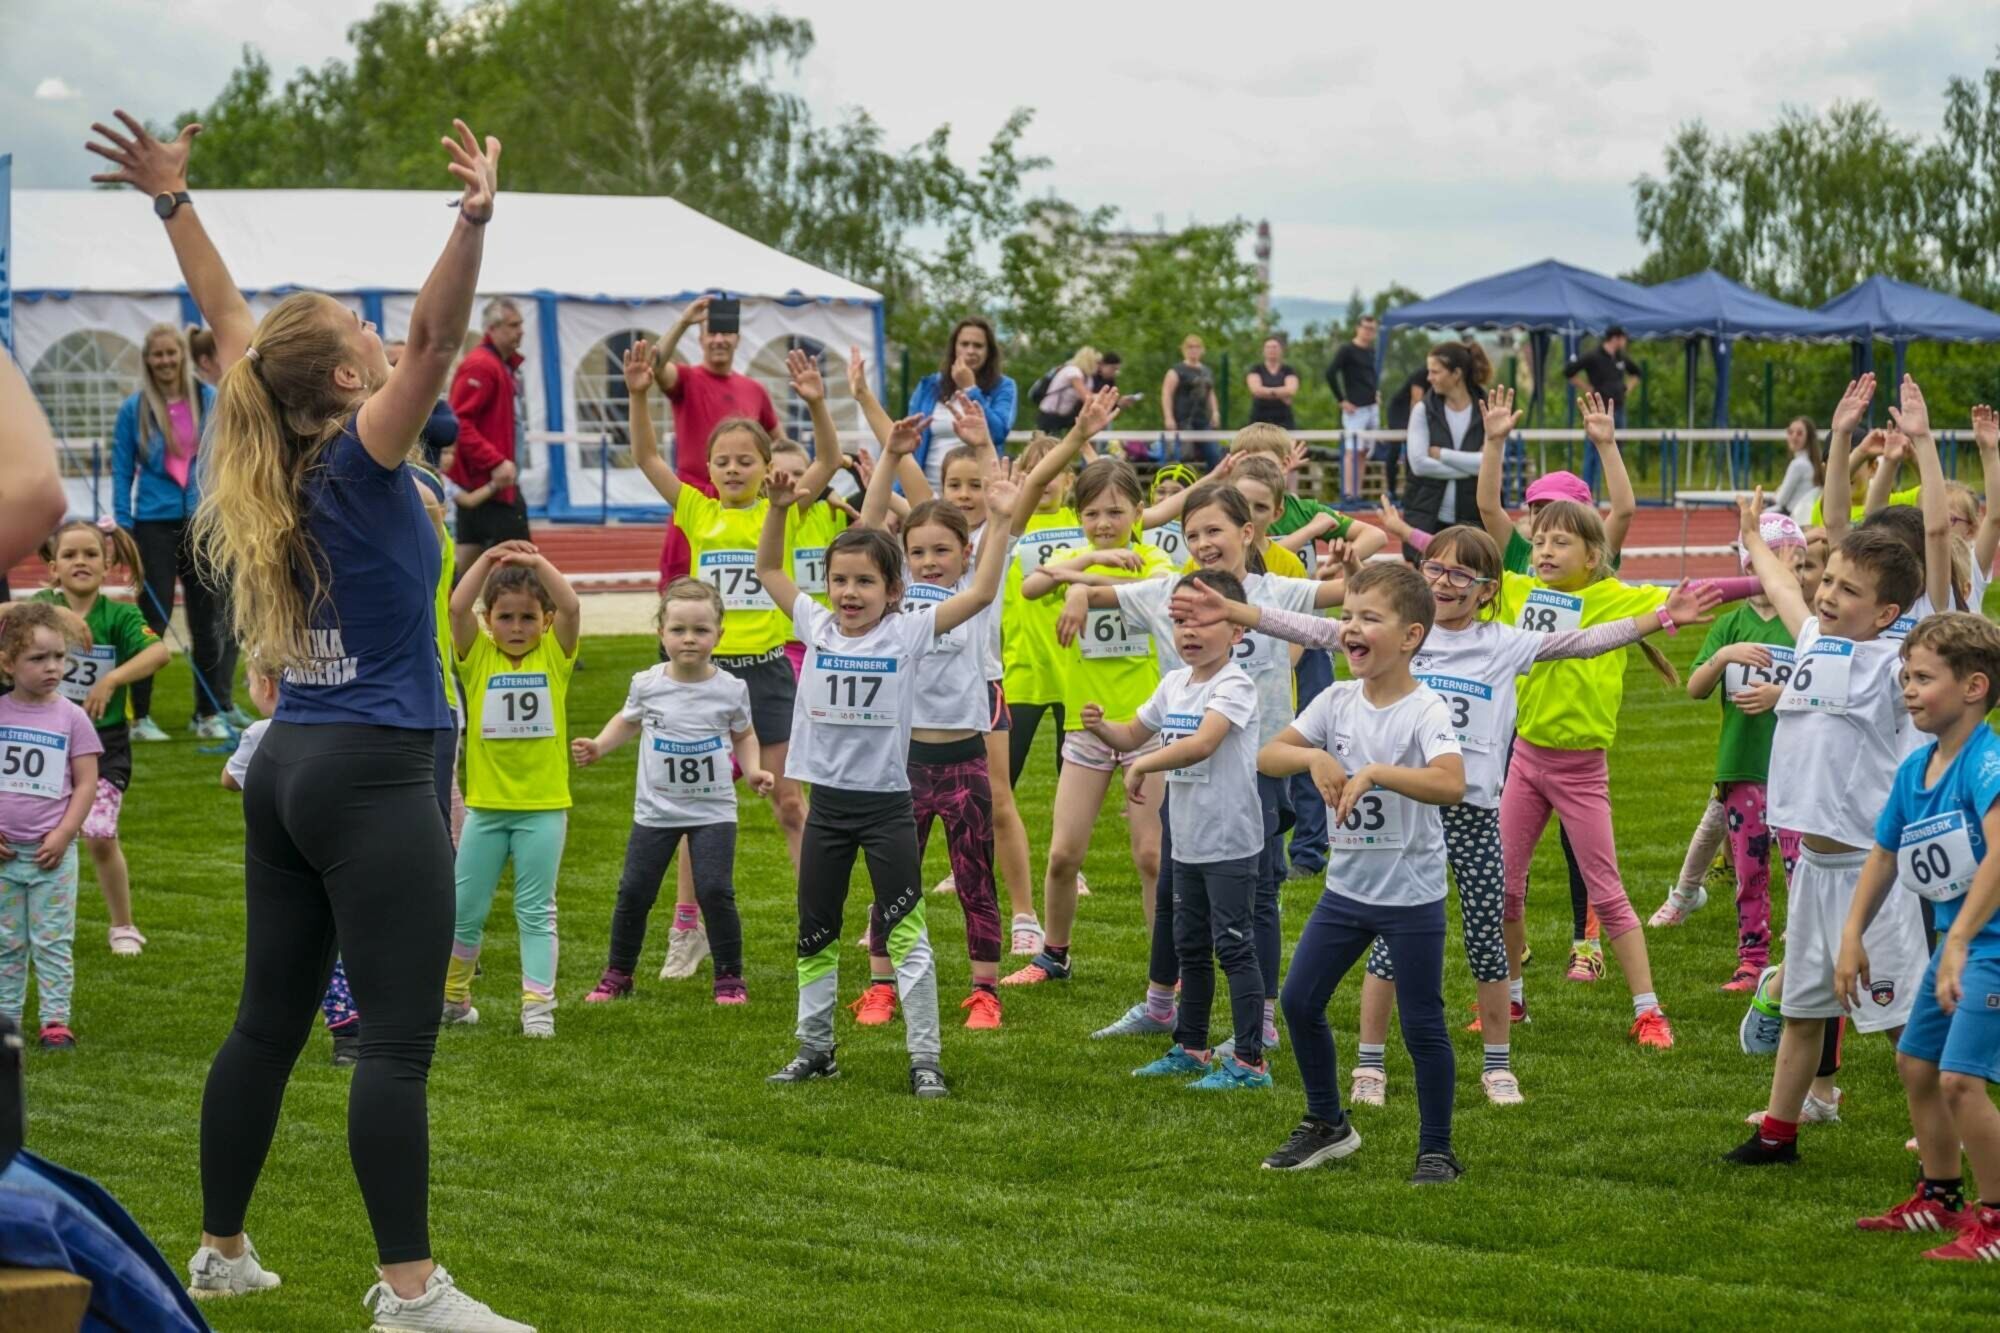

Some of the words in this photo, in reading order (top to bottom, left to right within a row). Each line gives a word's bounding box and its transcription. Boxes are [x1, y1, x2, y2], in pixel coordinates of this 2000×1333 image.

[706, 556, 717, 564] AK
[710, 568, 762, 595] 175
[63, 657, 98, 687] 23
[822, 658, 833, 667] AK
[833, 657, 889, 670] ŠTERNBERK
[1740, 664, 1793, 686] 158
[826, 674, 883, 708] 117
[1430, 677, 1486, 697] ŠTERNBERK
[502, 691, 539, 721] 19
[8, 729, 59, 747] ŠTERNBERK
[660, 741, 671, 751] AK
[671, 740, 718, 753] ŠTERNBERK
[2, 746, 45, 778] 50
[663, 755, 715, 783] 181
[1911, 842, 1951, 885] 60
